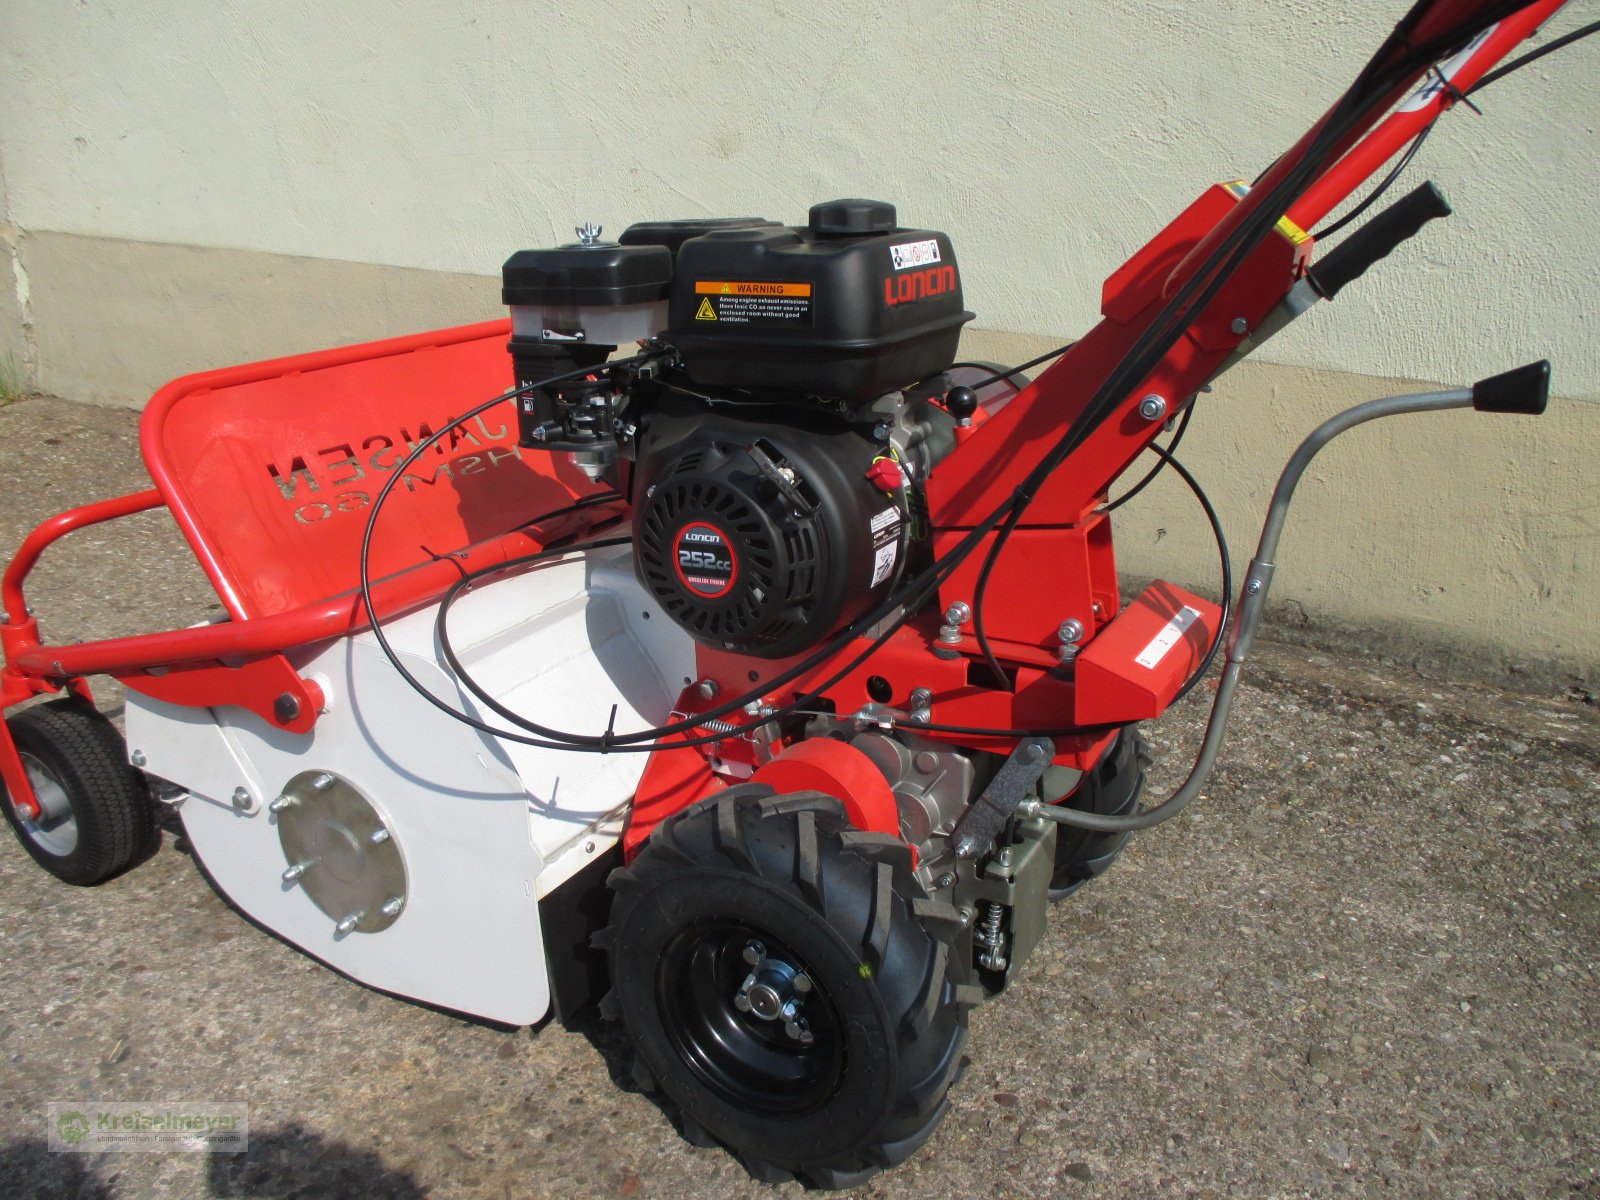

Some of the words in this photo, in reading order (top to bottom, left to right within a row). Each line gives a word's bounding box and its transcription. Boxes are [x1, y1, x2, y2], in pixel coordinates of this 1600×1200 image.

[737, 284, 784, 294] WARNING
[884, 265, 956, 306] LONCIN
[719, 296, 739, 304] Among
[685, 533, 720, 543] LONCIN
